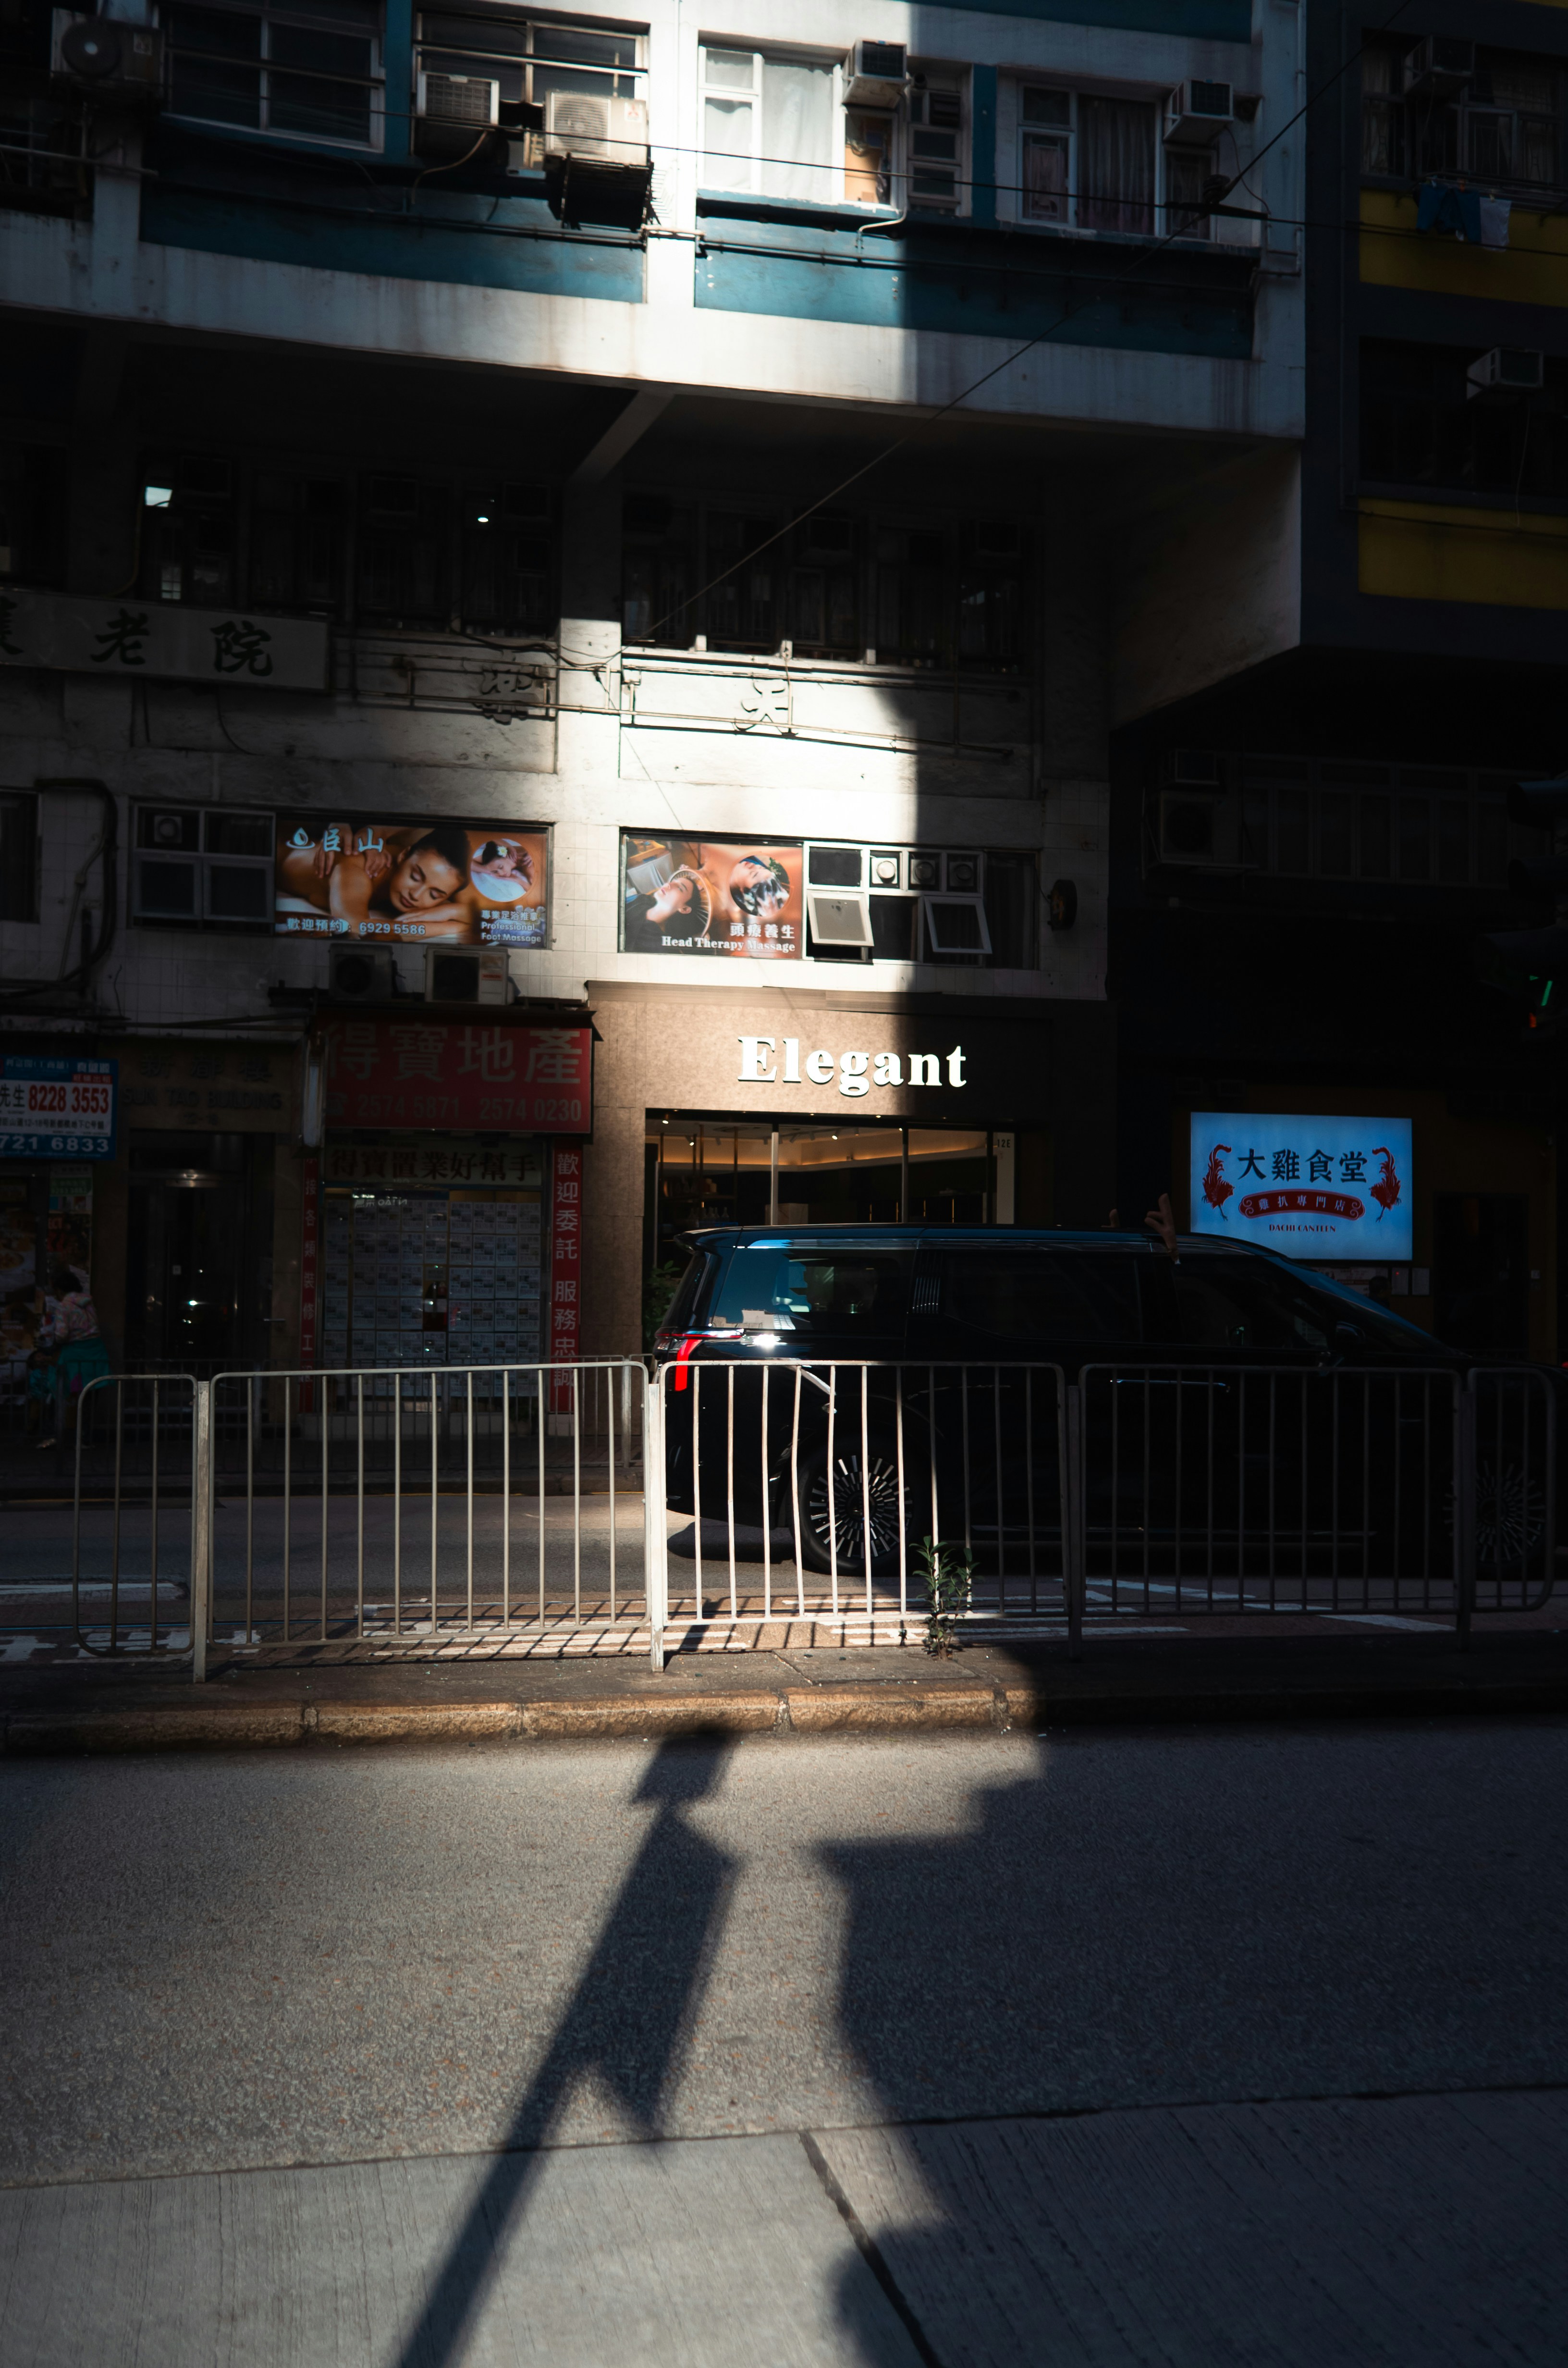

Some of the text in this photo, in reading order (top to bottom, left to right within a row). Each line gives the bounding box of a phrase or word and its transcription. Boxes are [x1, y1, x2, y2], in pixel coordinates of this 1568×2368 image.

[359, 922, 392, 934] 6929
[393, 923, 426, 936] 5586
[481, 921, 535, 931] Professional
[730, 923, 795, 938] 頭療養生
[503, 934, 542, 944] Massage
[662, 936, 795, 953] Head Therapy Massage
[322, 1021, 582, 1084] 得寶地產
[737, 1036, 967, 1098] Elegant
[28, 1085, 66, 1112] 8228
[72, 1086, 109, 1114] 3553
[122, 1086, 157, 1105] SUN
[357, 1095, 404, 1119] 2574
[480, 1098, 527, 1122] 2574
[534, 1099, 582, 1122] 0230
[51, 1136, 110, 1152] 6833
[997, 1138, 1011, 1148] 12E
[1237, 1148, 1368, 1184] 大雞食堂
[555, 1152, 579, 1260] 歡迎委託
[1258, 1194, 1346, 1212] 雞扒專門店
[1269, 1224, 1336, 1233] DACHI CANTEEN
